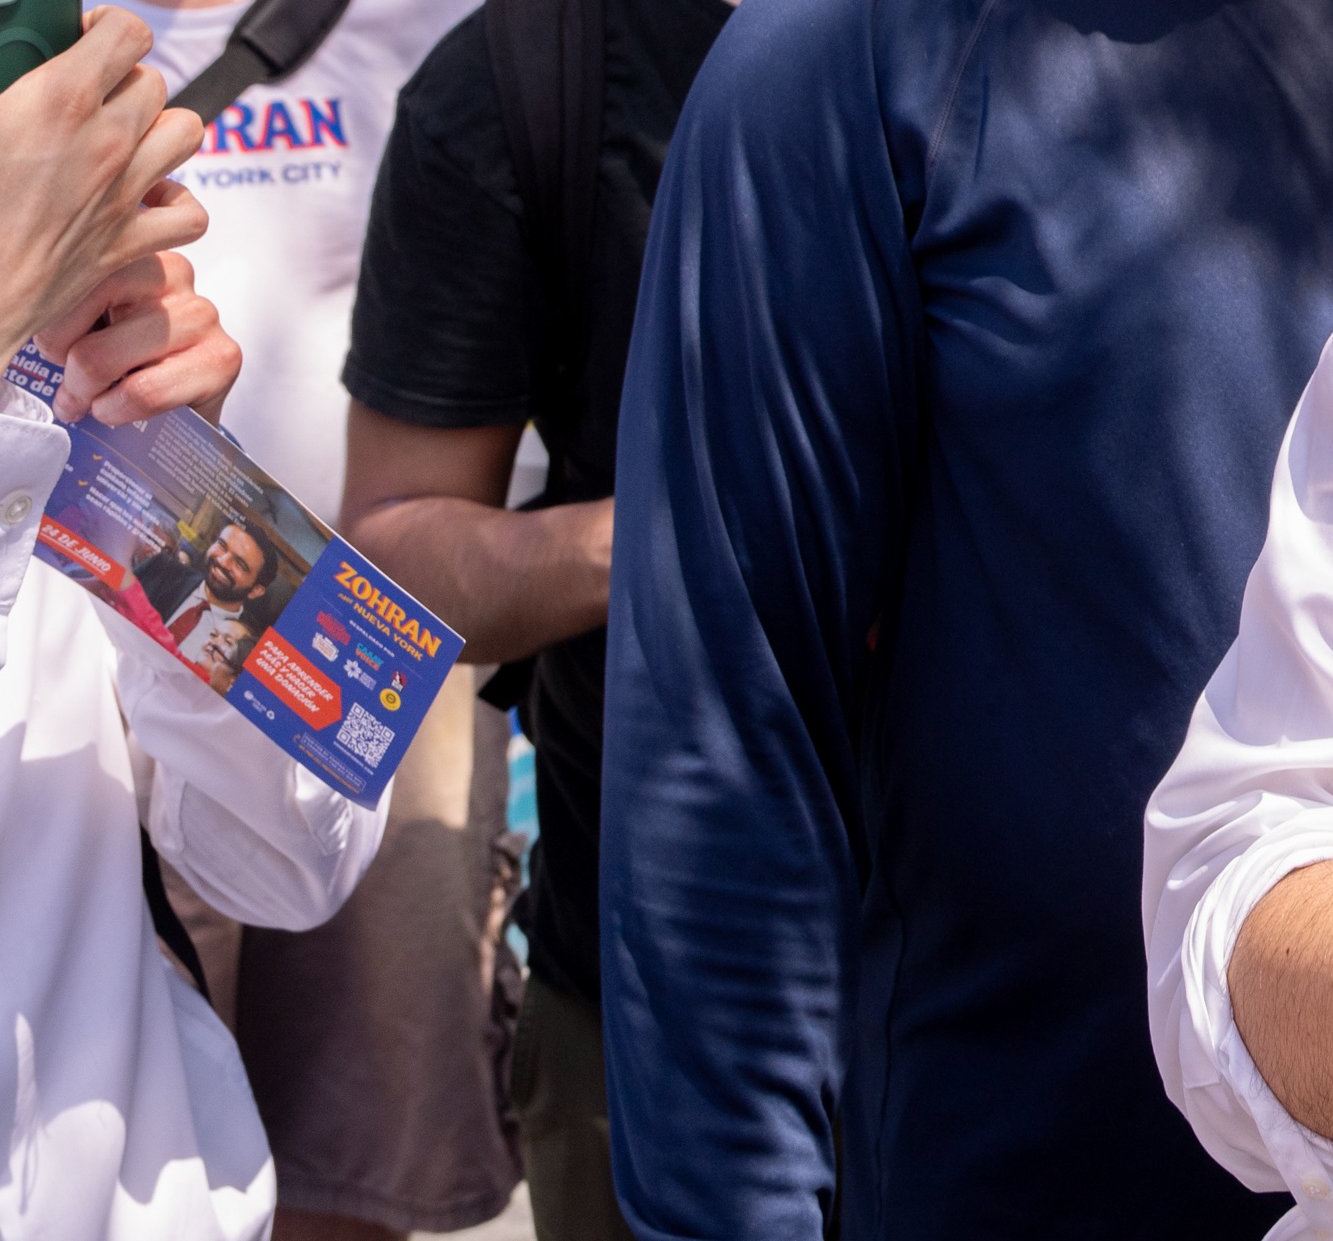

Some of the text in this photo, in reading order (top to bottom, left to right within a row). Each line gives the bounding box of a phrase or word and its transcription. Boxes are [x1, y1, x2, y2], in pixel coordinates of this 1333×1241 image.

[196, 97, 349, 153] RAN
[195, 167, 275, 190] YORK
[281, 161, 341, 184] CITY
[30, 380, 55, 396] de
[41, 524, 111, 572] 24 DE JUNIO
[334, 561, 442, 659] ZOHRAN
[352, 602, 391, 637] NUEVA
[393, 632, 423, 661] YORK
[255, 657, 276, 678] UNA
[275, 673, 321, 714] DONACIÓN
[260, 647, 282, 670] MÁS
[286, 668, 316, 699] HACER
[264, 640, 289, 663] PARA
[286, 657, 334, 702] APRENDER
